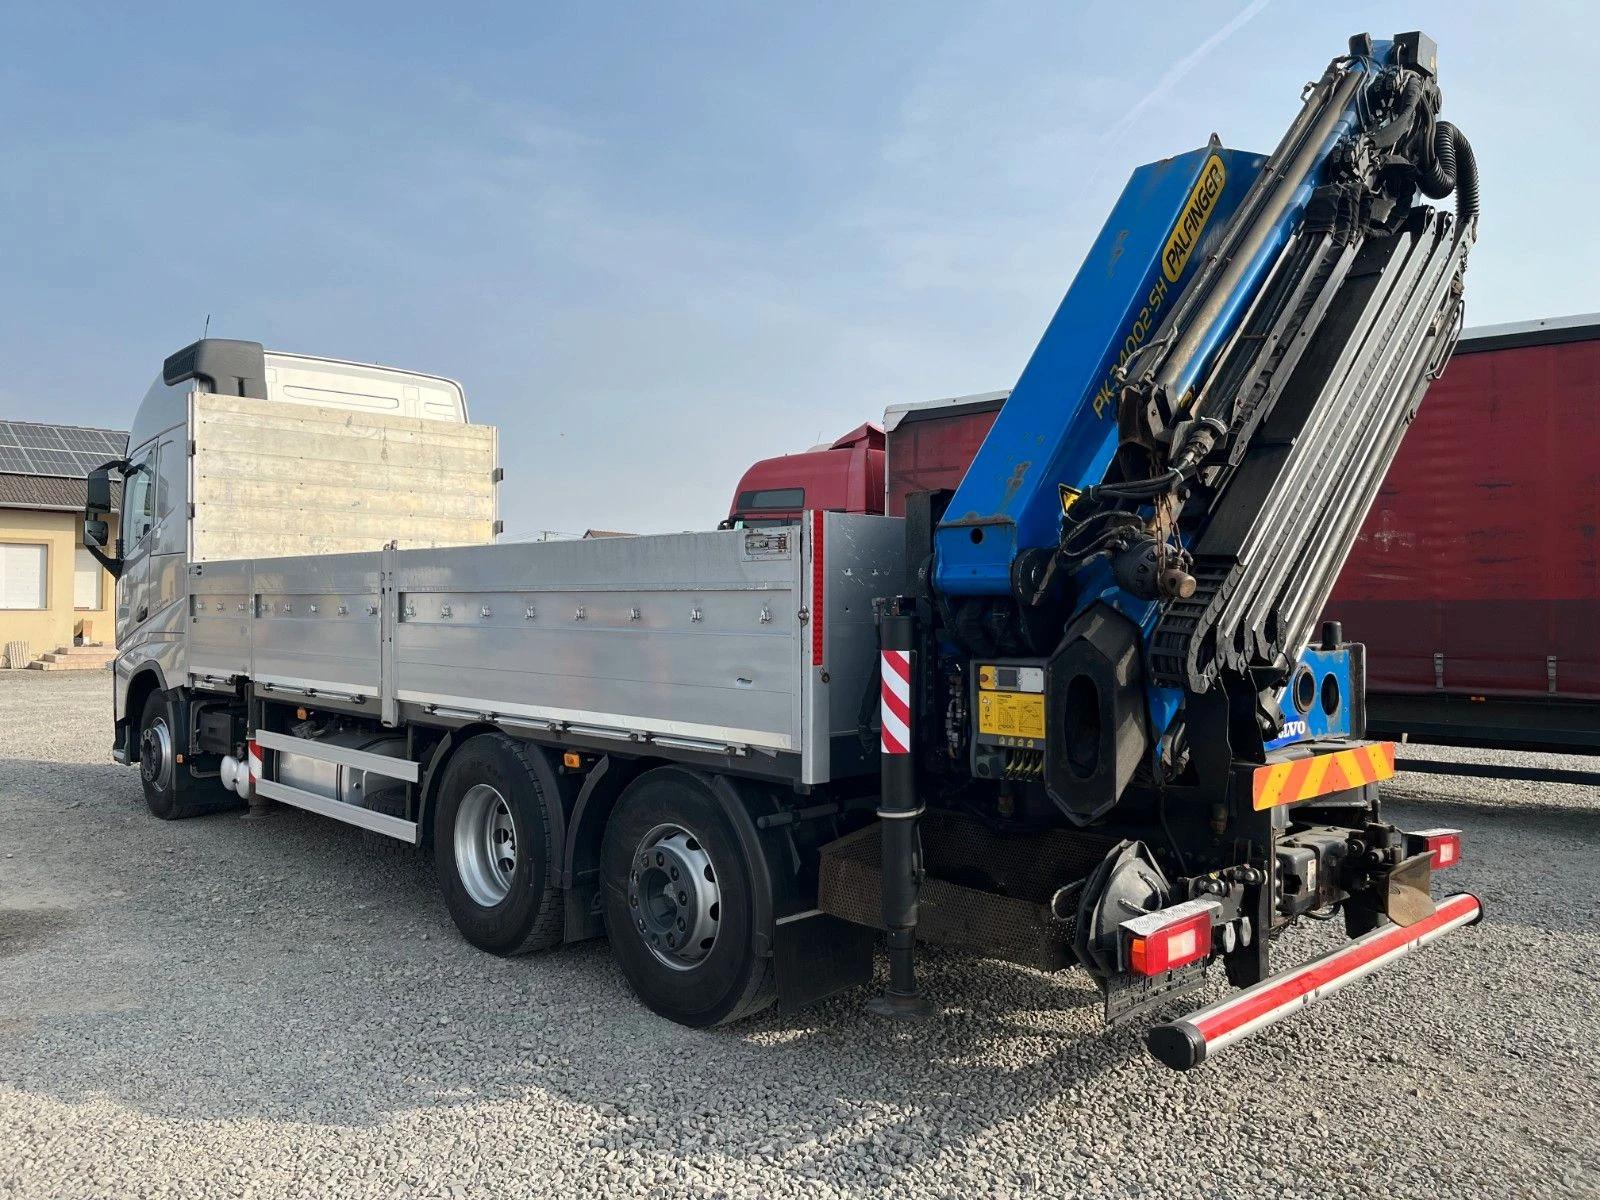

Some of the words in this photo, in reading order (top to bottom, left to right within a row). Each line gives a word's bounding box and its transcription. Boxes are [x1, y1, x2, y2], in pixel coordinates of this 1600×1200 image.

[1165, 163, 1223, 276] PALFINGER
[1092, 379, 1115, 420] PK
[1274, 720, 1306, 741] LVO
